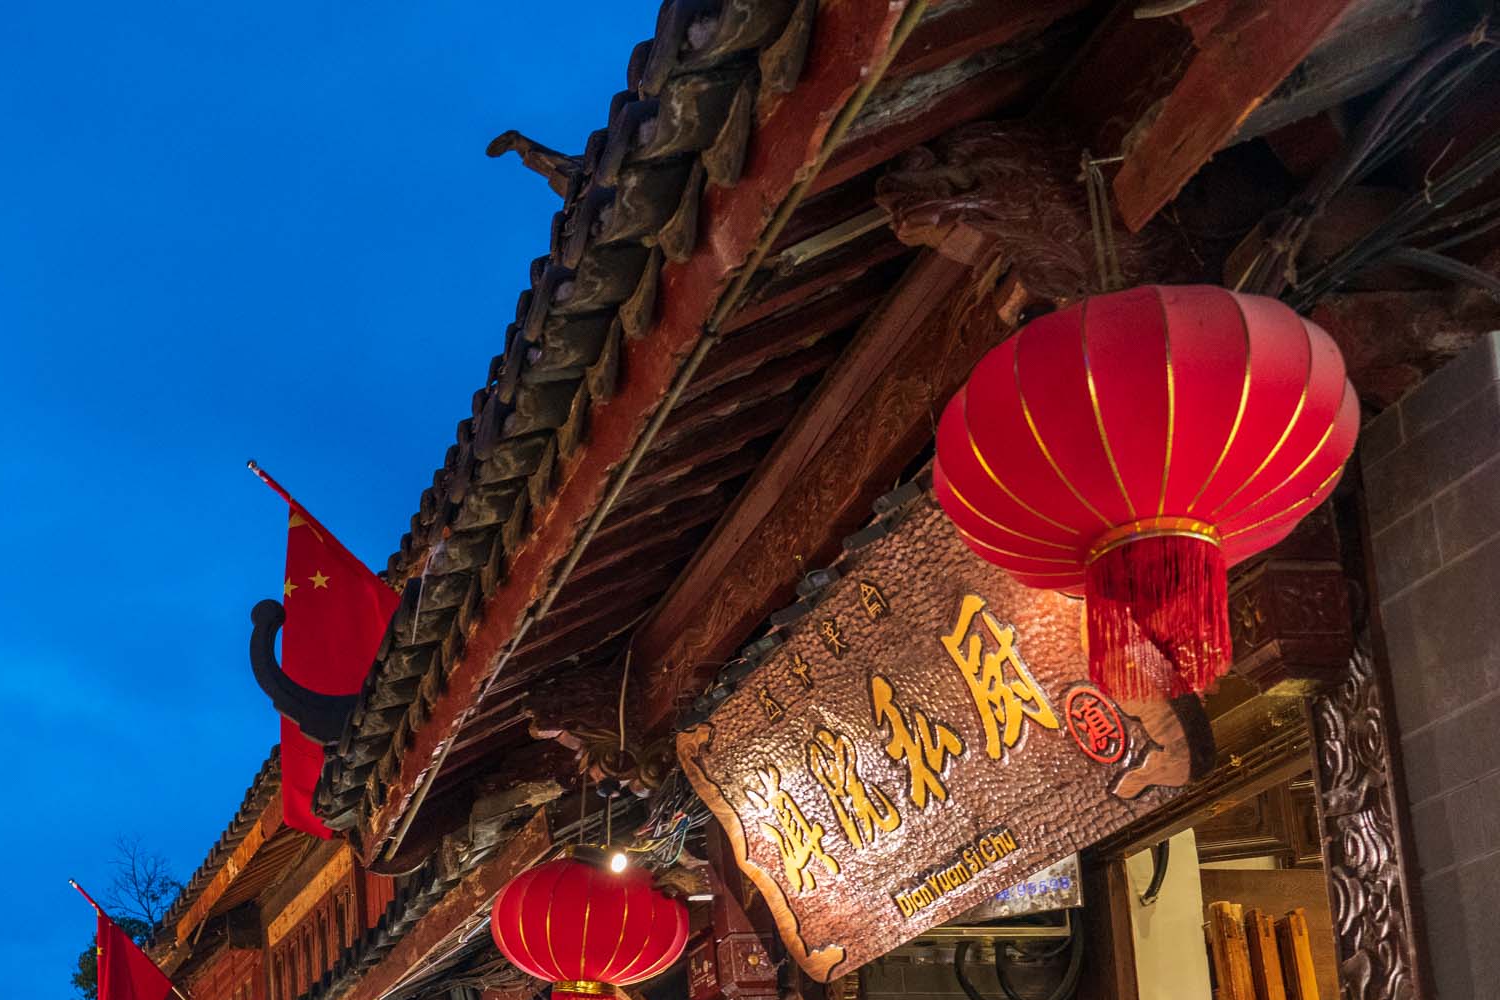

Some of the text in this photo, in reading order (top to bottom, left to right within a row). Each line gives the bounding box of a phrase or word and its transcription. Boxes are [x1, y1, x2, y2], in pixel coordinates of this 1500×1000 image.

[895, 829, 1017, 918] Dian Yuan Si Chu
